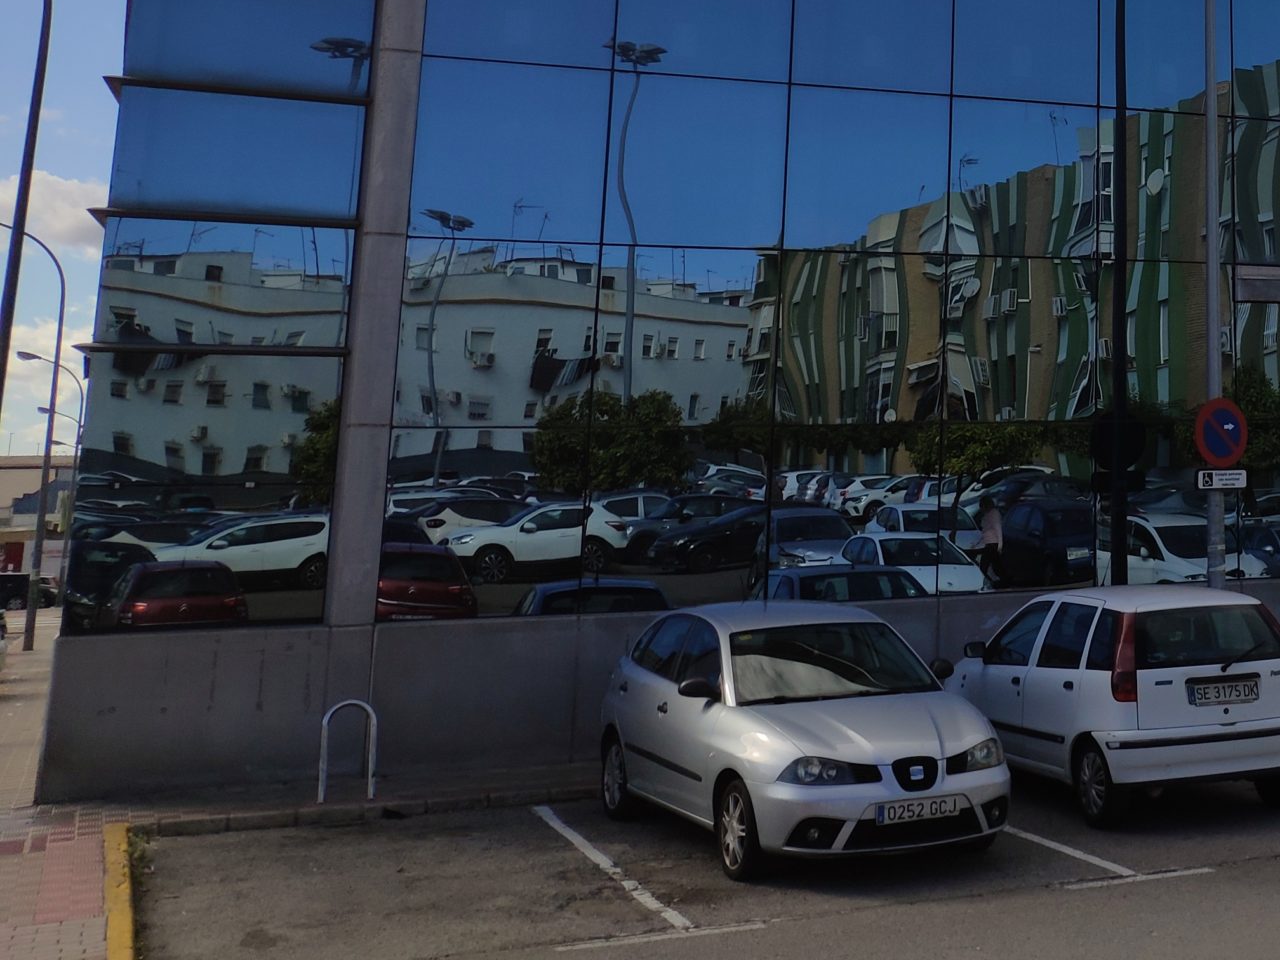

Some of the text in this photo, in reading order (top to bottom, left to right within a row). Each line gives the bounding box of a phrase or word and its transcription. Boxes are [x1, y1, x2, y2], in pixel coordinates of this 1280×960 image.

[1196, 681, 1258, 701] SE 3175 DK
[888, 798, 957, 821] 0252 GCJ
